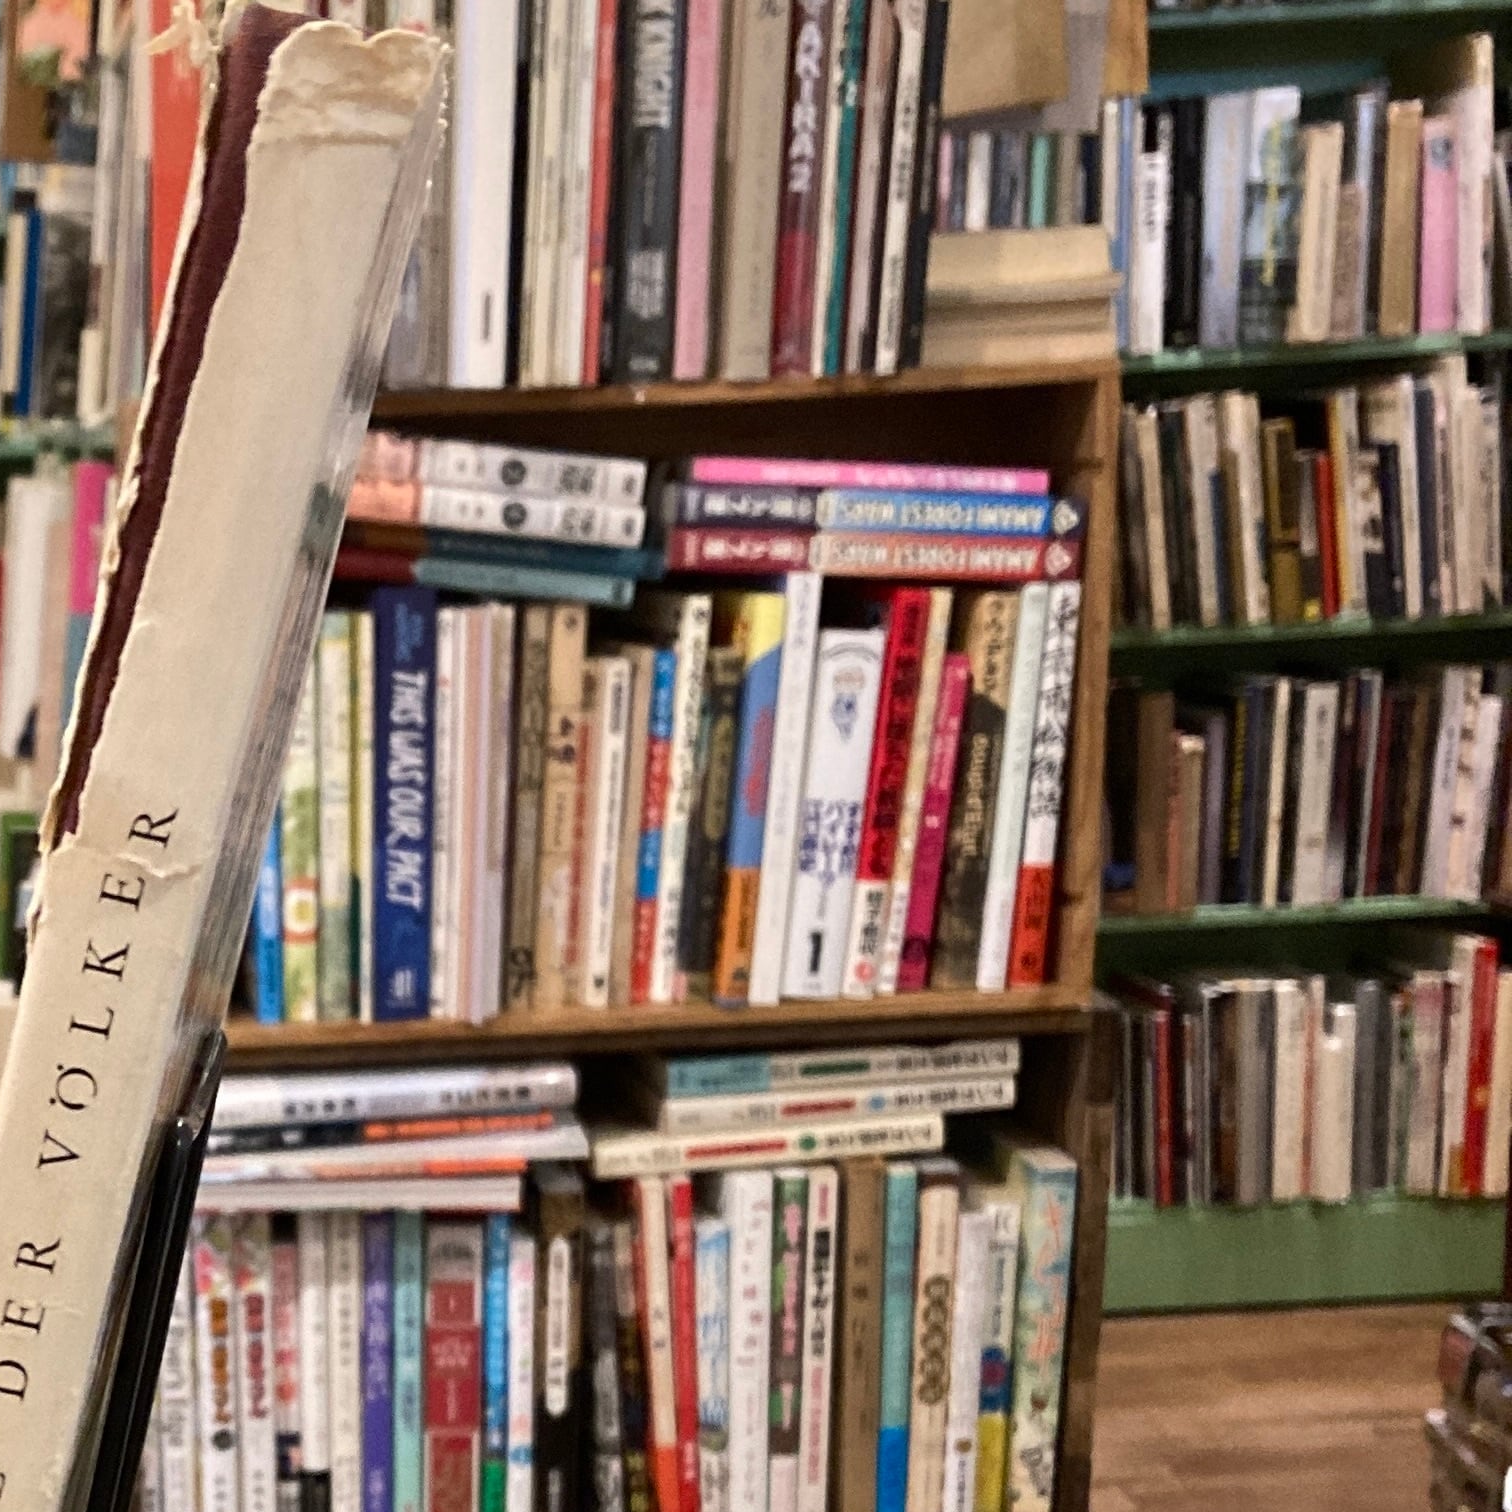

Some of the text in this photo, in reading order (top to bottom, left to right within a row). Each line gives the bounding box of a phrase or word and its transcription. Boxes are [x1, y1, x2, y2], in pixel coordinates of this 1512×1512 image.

[389, 669, 429, 728] THIS
[387, 729, 428, 784] WAS
[386, 786, 427, 847] OUR
[384, 846, 423, 911] PACT
[37, 807, 179, 1169] VÖLKER
